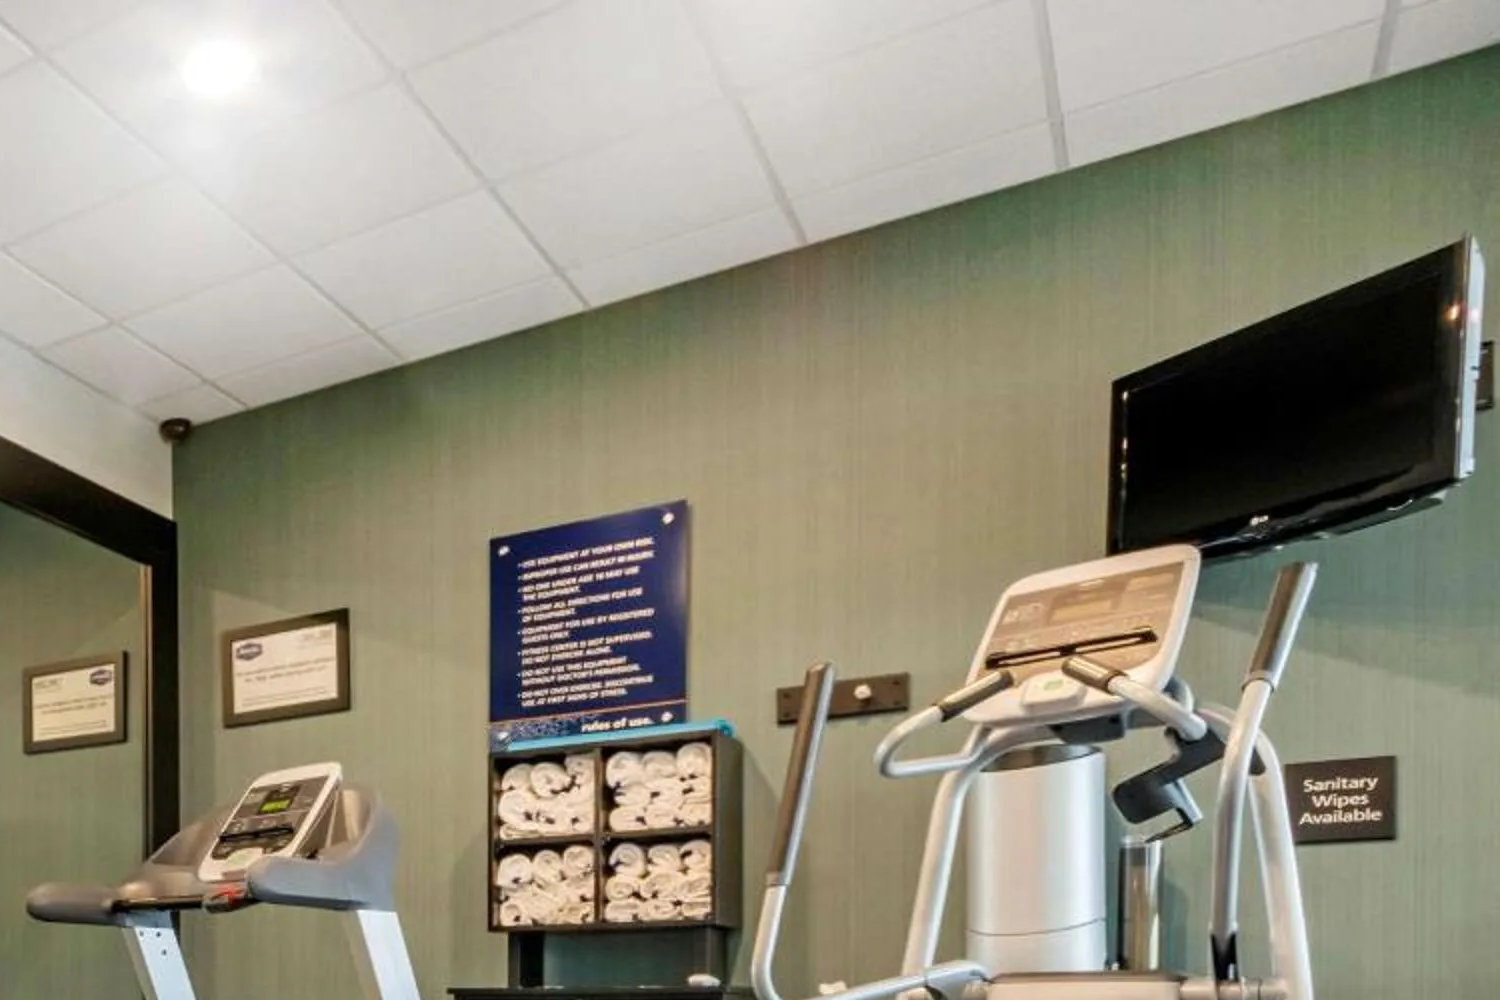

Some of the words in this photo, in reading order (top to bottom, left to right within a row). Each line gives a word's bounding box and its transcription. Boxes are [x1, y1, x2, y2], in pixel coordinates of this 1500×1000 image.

[581, 720, 611, 734] rules
[612, 716, 627, 730] of
[628, 716, 655, 728] use.
[1303, 777, 1379, 793] Sanitary
[1311, 793, 1370, 808] Wipes
[1299, 807, 1383, 825] Available
